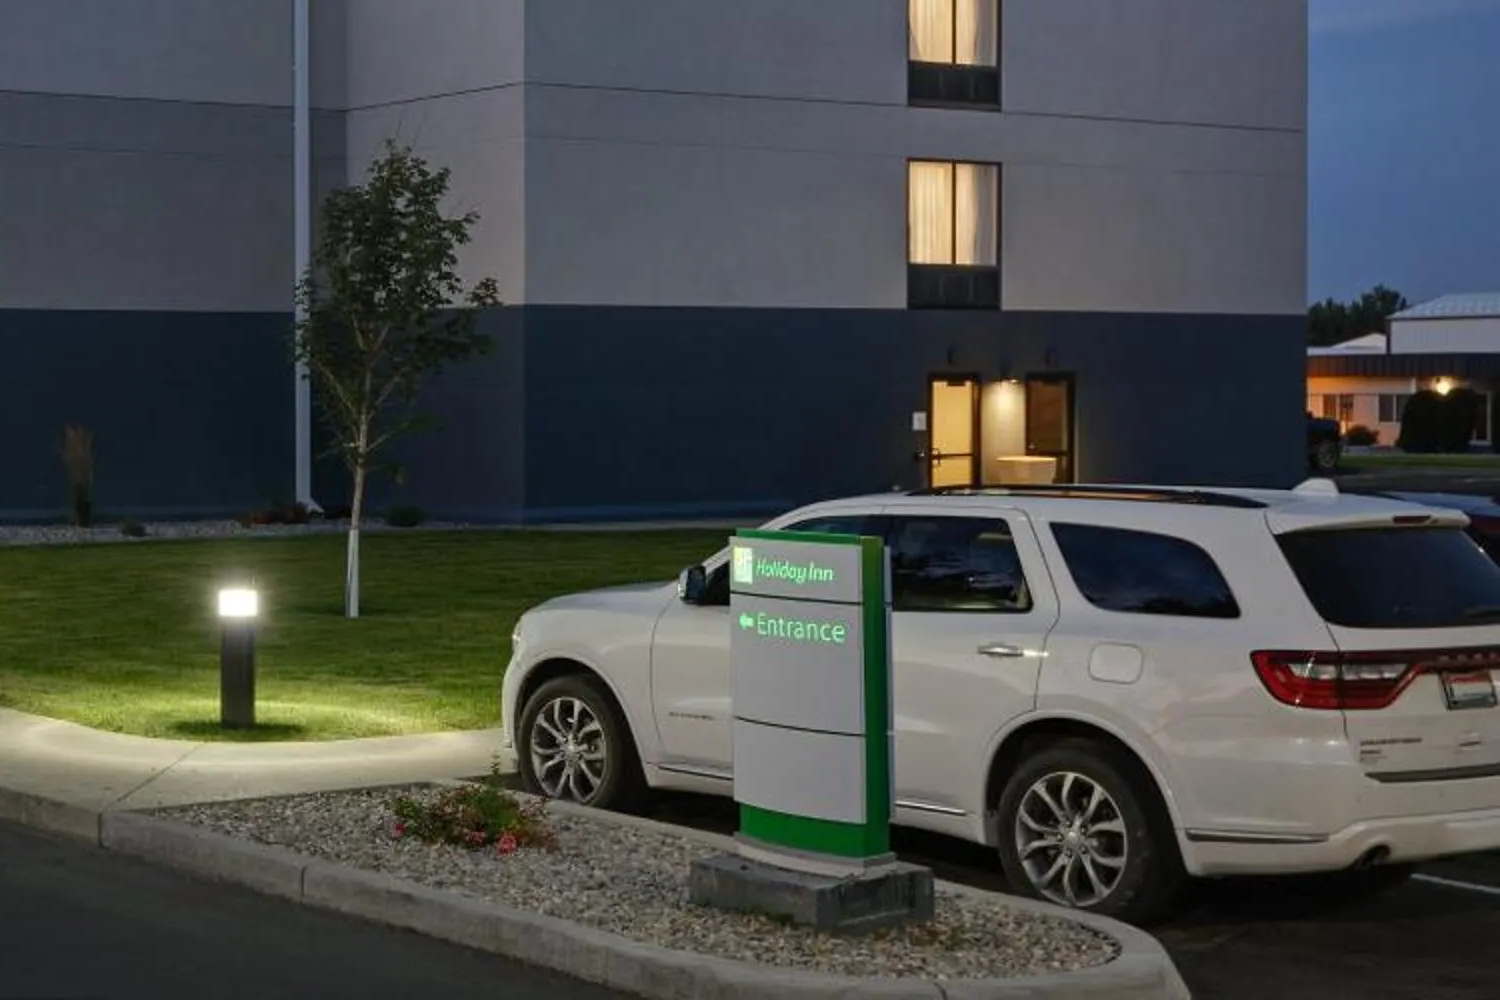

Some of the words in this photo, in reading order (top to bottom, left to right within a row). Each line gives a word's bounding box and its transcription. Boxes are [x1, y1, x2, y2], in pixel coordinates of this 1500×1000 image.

[755, 558, 807, 584] Holiday
[808, 561, 834, 581] Inn
[756, 612, 846, 643] Entrance
